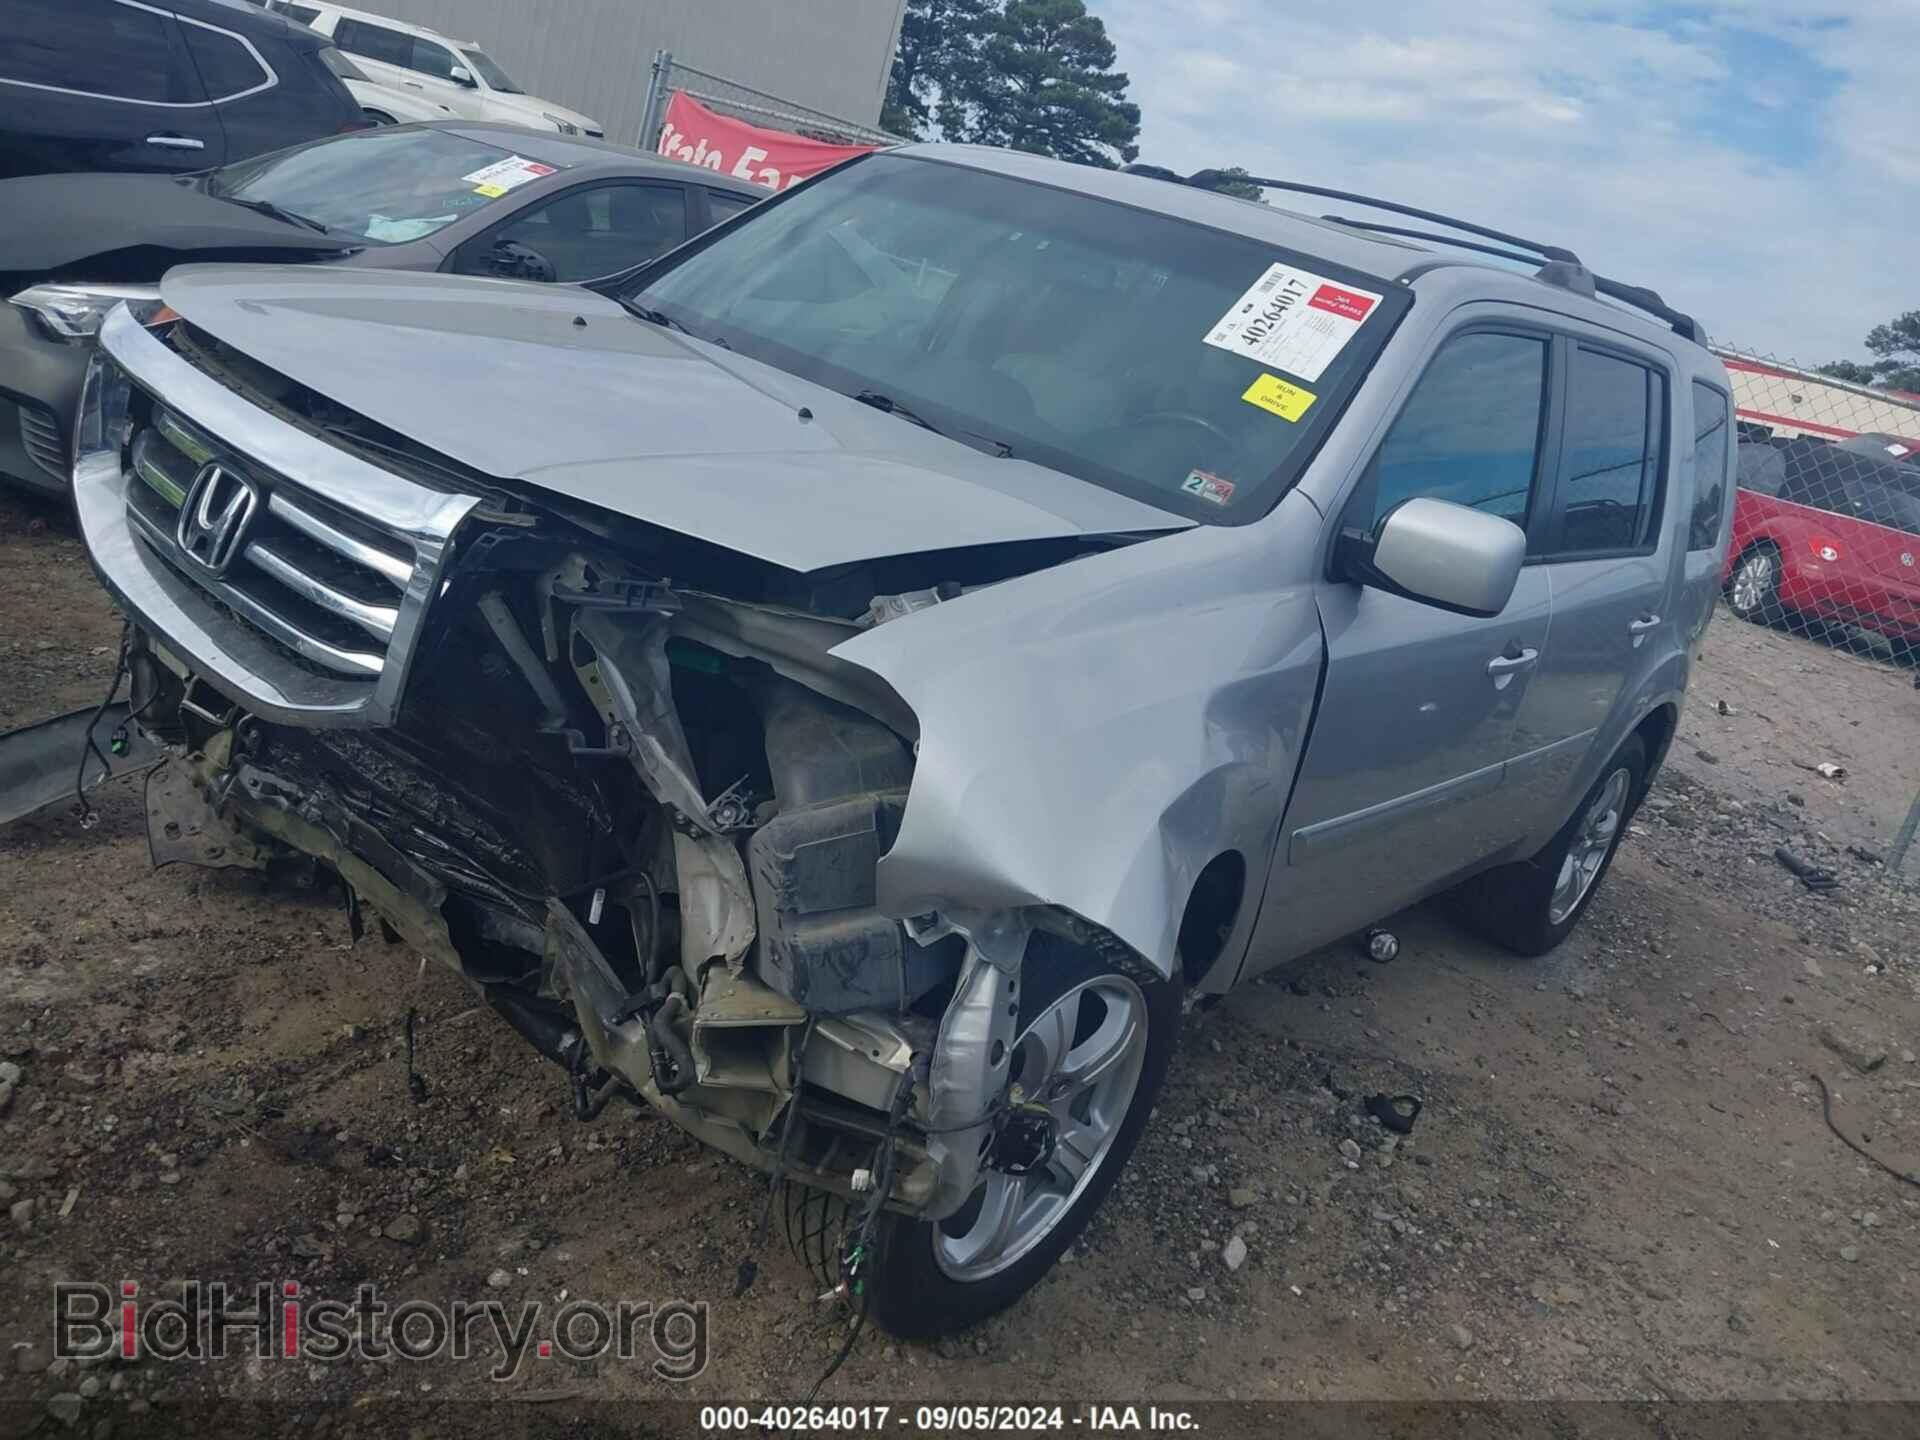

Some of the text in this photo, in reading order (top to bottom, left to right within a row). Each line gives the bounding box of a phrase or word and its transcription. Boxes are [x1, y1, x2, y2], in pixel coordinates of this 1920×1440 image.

[1241, 279, 1308, 346] 40264017
[1276, 384, 1297, 397] RUN
[1260, 395, 1289, 411] DRIVE
